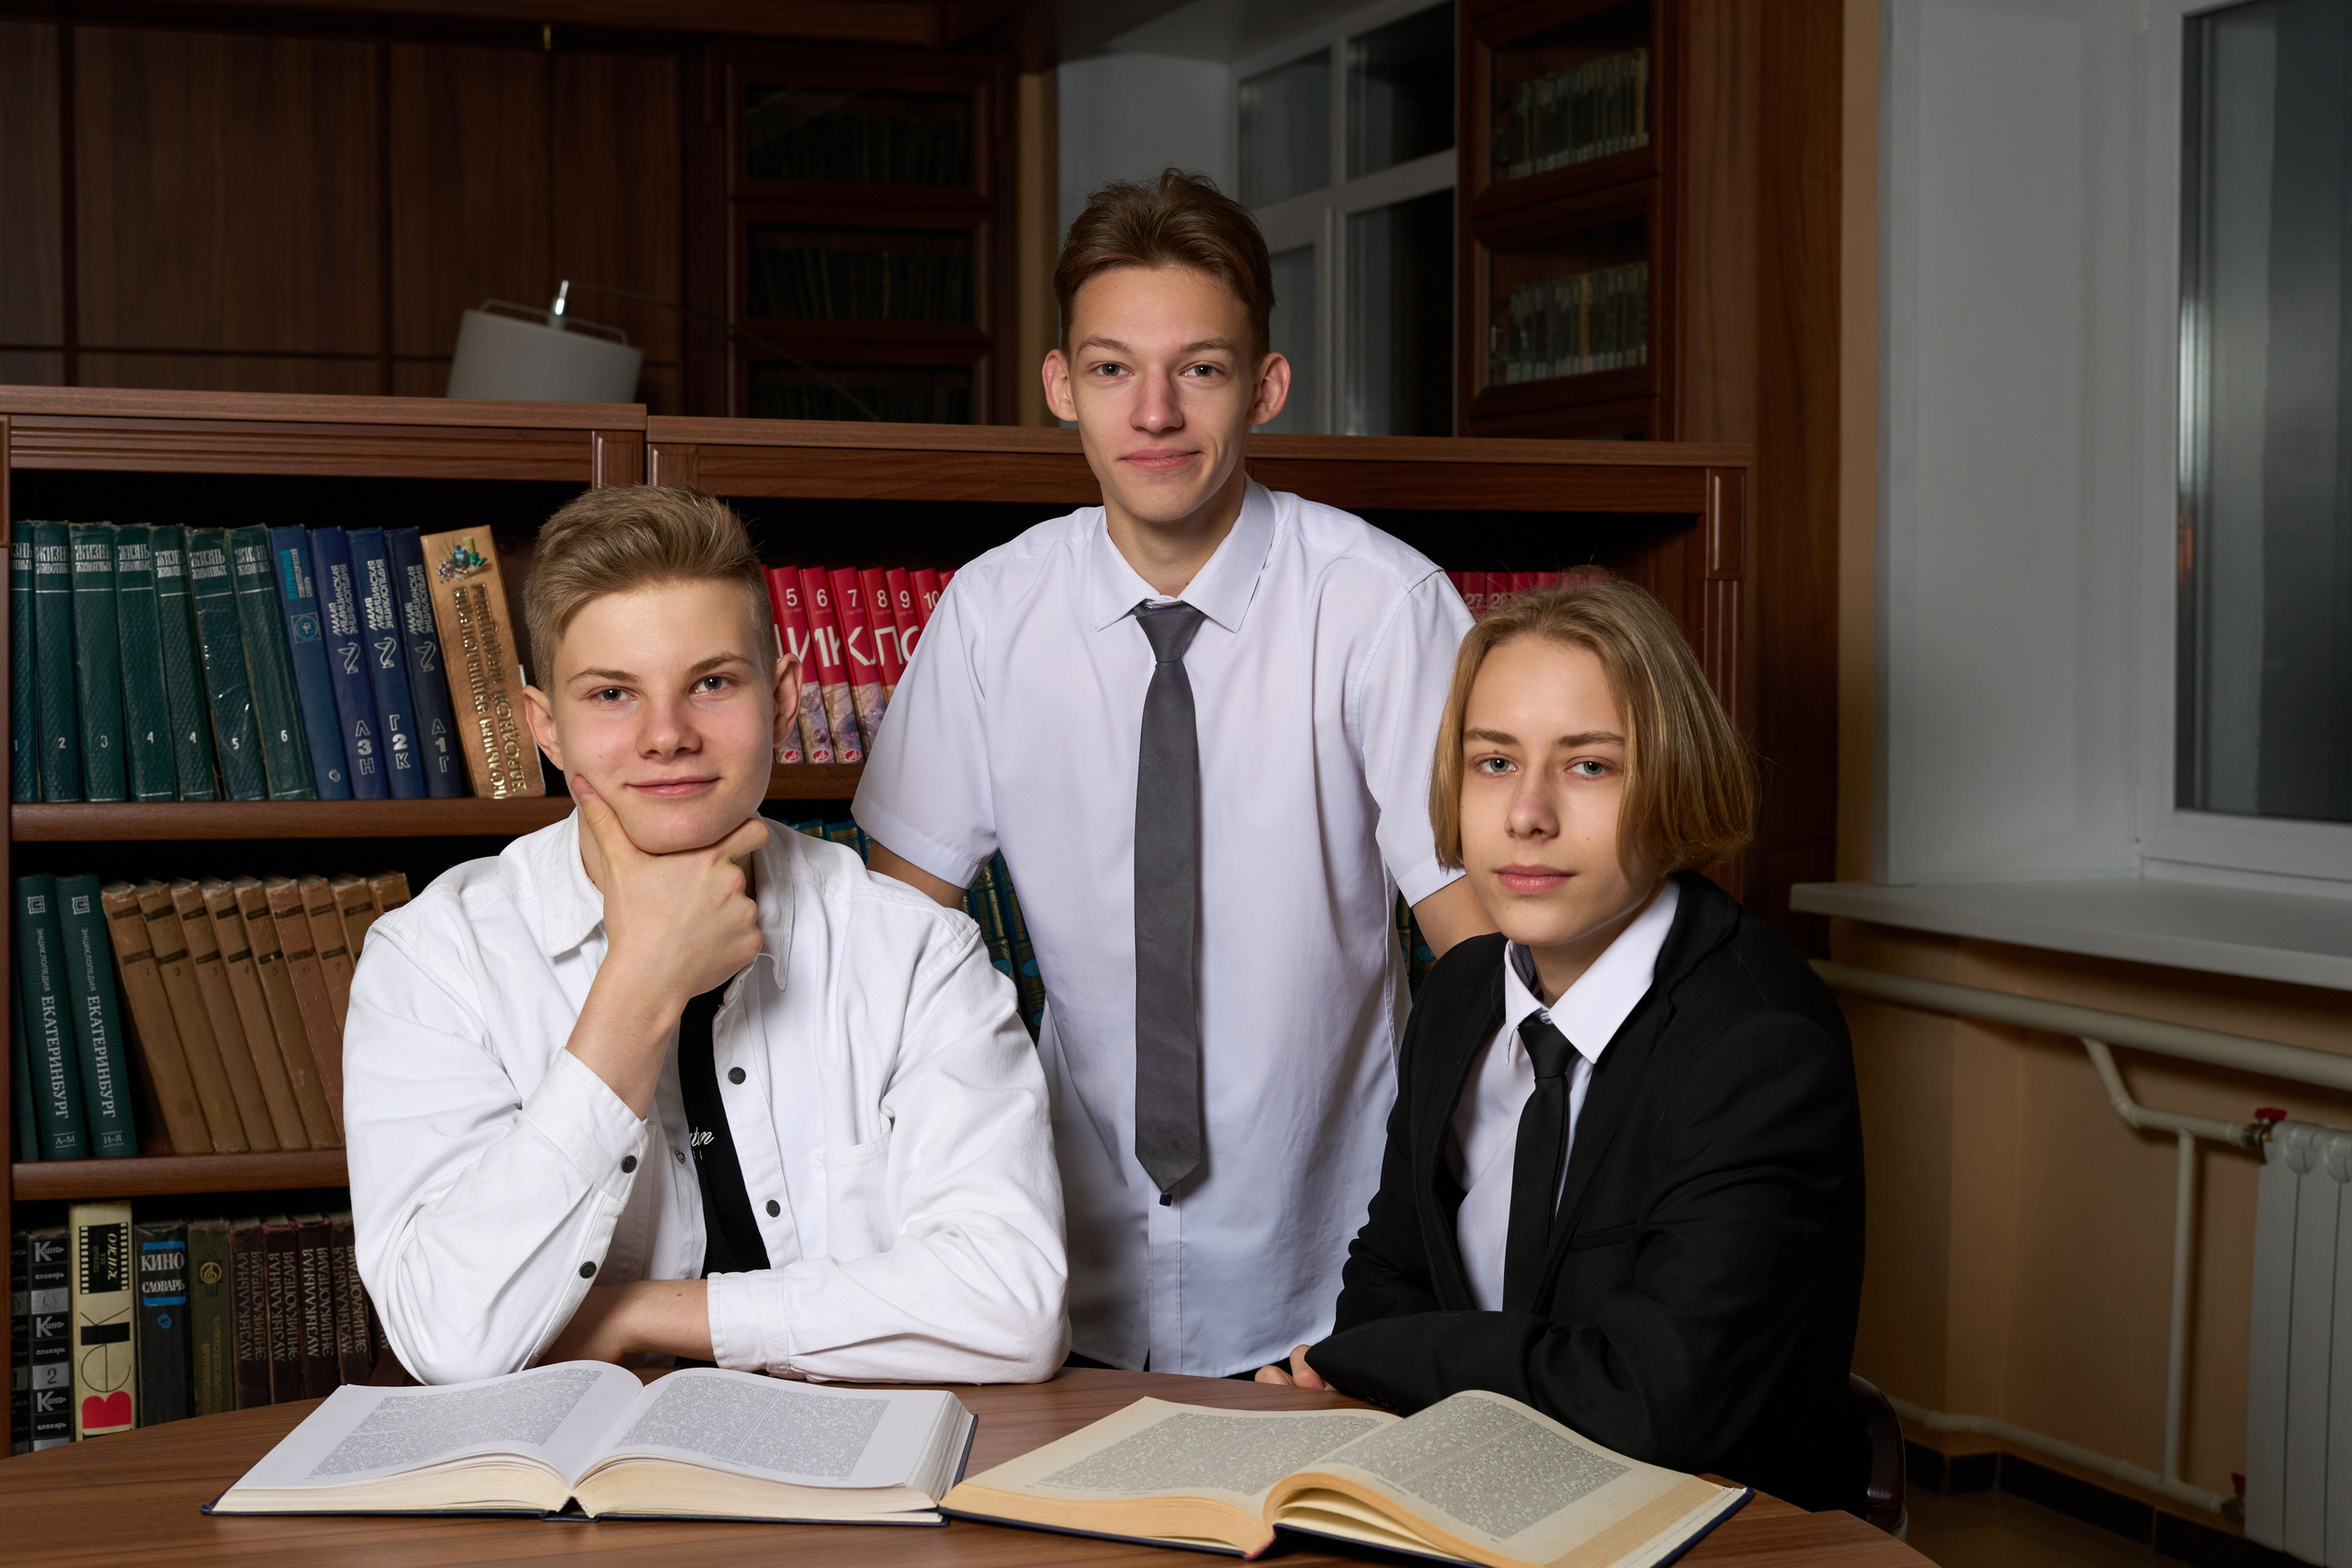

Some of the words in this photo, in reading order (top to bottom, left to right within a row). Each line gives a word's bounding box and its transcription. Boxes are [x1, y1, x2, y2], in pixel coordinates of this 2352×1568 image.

[11, 543, 33, 558] ЗНЬ
[74, 544, 111, 560] ЖИЗНЬ
[118, 544, 150, 560] ЖИЗНЬ
[189, 548, 225, 568] ЖИЗНЬ
[331, 564, 351, 635] МЕДИЦИНСКАЯ
[339, 563, 358, 635] ЭНЦИКЛОПЕДИЯ
[367, 559, 386, 629] МЕДИЦИНСКАЯ
[376, 558, 394, 629] ЭНЦИКЛОПЕДИЯ
[407, 565, 426, 634] МЕДИЦИНСКАЯ
[415, 564, 434, 634] ЭНЦИКЛОПЕДИЯ
[786, 588, 797, 606] 5
[817, 589, 828, 607] 6
[847, 589, 857, 607] 7
[876, 589, 888, 608] 8
[899, 590, 910, 608] 9
[1464, 592, 1483, 610] 27
[328, 602, 342, 637] МАЛАЯ
[364, 597, 378, 631] МАЛАЯ
[404, 602, 418, 636] МАЛАЯ
[356, 720, 370, 738] Л
[390, 714, 400, 731] Г
[432, 718, 447, 735] А
[58, 737, 66, 750] 2
[100, 736, 108, 748] 3
[147, 731, 154, 743] 4
[189, 731, 197, 743] 4
[232, 738, 239, 750] 5
[280, 729, 288, 742] 6
[391, 733, 408, 750] 2
[435, 737, 447, 752] 1
[13, 739, 18, 751] 1
[357, 739, 372, 755] 3
[359, 757, 375, 775] Н
[395, 752, 411, 770] К
[439, 756, 449, 773] Г
[37, 928, 51, 991] ЭНЦИКЛОПЕДИЯ
[81, 928, 96, 991] ЭНЦИКЛОПЕДИЯ
[334, 963, 341, 972] 7
[175, 967, 181, 976] 2
[243, 964, 249, 974] 4
[272, 966, 278, 976] 5
[41, 996, 69, 1119] ЕКАТЕРИНБУРГ
[87, 995, 116, 1119] ЕКАТЕРИНБУРГ
[141, 1253, 186, 1272] КИНО
[35, 1271, 64, 1281] словарь
[141, 1280, 186, 1294] СЛОВАРЬ
[236, 1252, 253, 1361] МУЗЫКАЛЬНАЯ
[251, 1251, 266, 1360] ЭНЦИКЛОПЕДИЯ
[268, 1252, 286, 1361] МУЗЫКАЛЬНАЯ
[283, 1251, 299, 1361] ЭНЦИКЛОПЕДИЯ
[301, 1248, 320, 1358] МУЗЫКАЛЬНАЯ
[316, 1247, 334, 1357] ЭНЦИКЛОПЕДИЯ
[333, 1247, 353, 1354] МУЗЫКАЛЬНАЯ
[36, 1347, 66, 1356] словарь
[47, 1368, 57, 1384] 2
[37, 1422, 67, 1431] словарь
